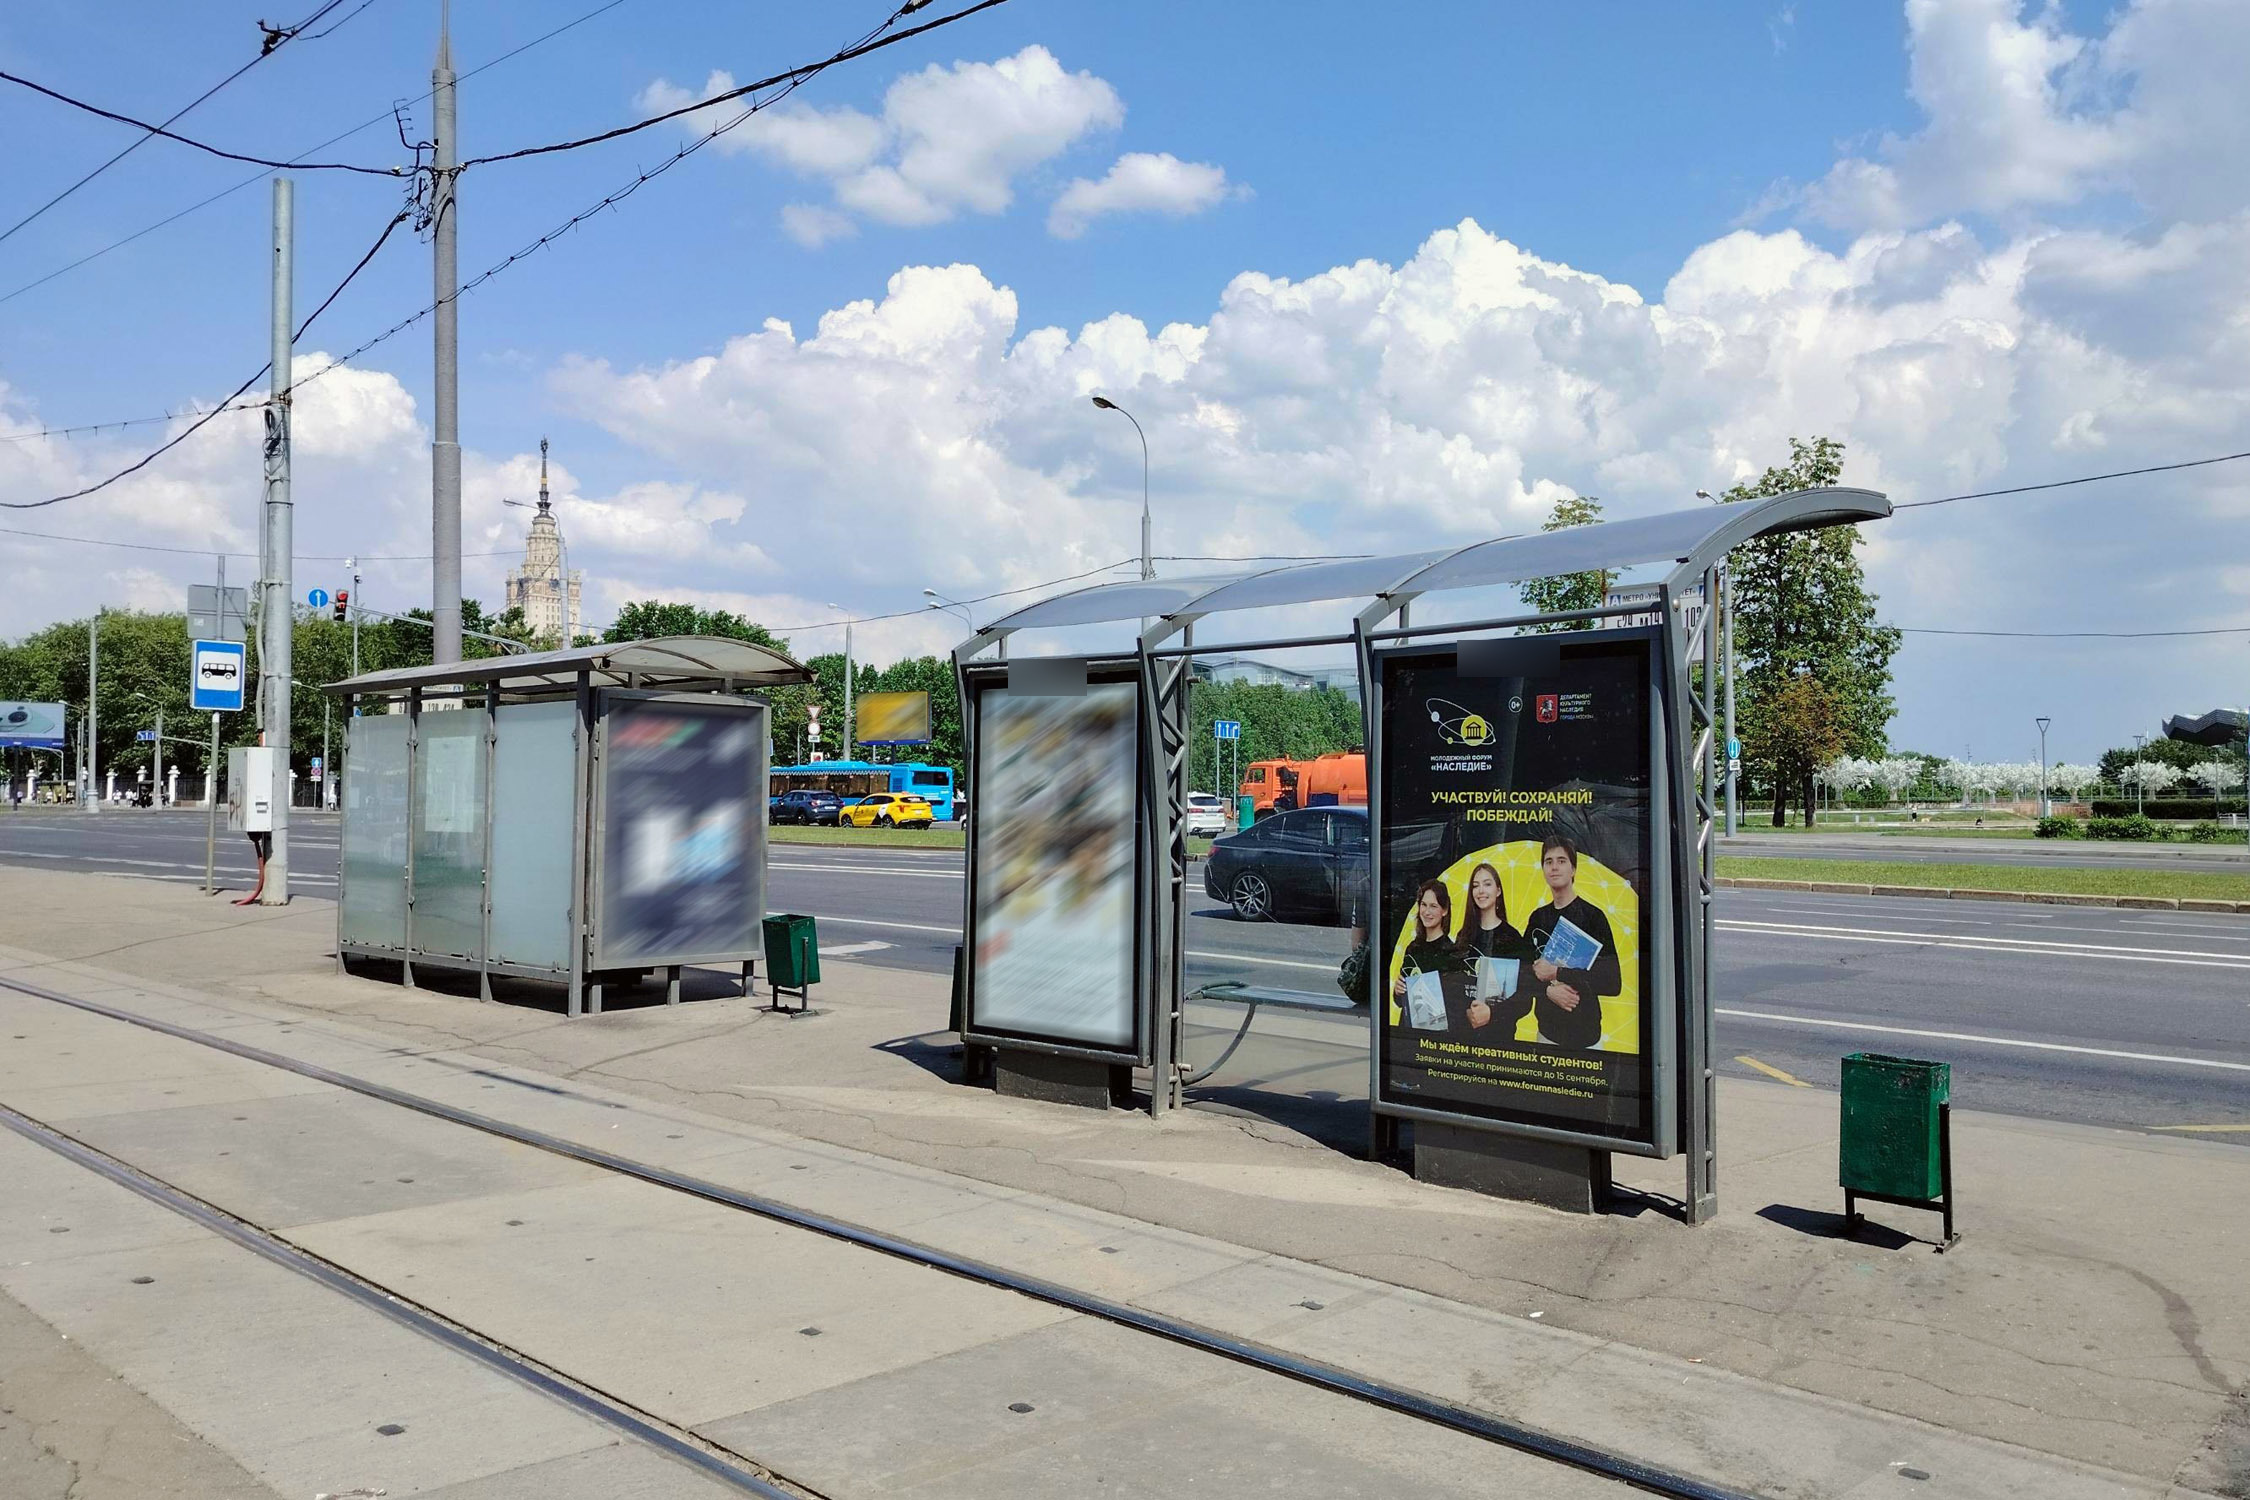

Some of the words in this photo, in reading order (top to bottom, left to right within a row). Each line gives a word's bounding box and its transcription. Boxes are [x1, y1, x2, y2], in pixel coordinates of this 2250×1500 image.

[1622, 592, 1644, 602] МЕТРО
[1511, 701, 1521, 709] 0+
[1431, 762, 1492, 772] «НАСЛЕДИЕ»
[1431, 789, 1506, 804] УЧАСТВУЙ!
[1509, 788, 1593, 804] СОХРАНЯЙ!
[1466, 807, 1553, 823] ПОБЕЖДАЙ!
[1420, 1038, 1436, 1050] Мы
[1440, 1042, 1469, 1054] ждём
[1471, 1046, 1538, 1063] креативных
[1540, 1055, 1603, 1071] студентов!
[1415, 1053, 1442, 1064] Заявки
[1443, 1058, 1453, 1066] на
[1454, 1059, 1485, 1070] участие
[1486, 1063, 1542, 1078] принимаются
[1544, 1070, 1555, 1080] до
[1556, 1071, 1565, 1081] 15
[1566, 1073, 1609, 1087] сентября.
[1427, 1068, 1486, 1083] Регистрируйся
[1488, 1078, 1498, 1086] на
[1499, 1079, 1594, 1099] www.forumnasledie.ru
